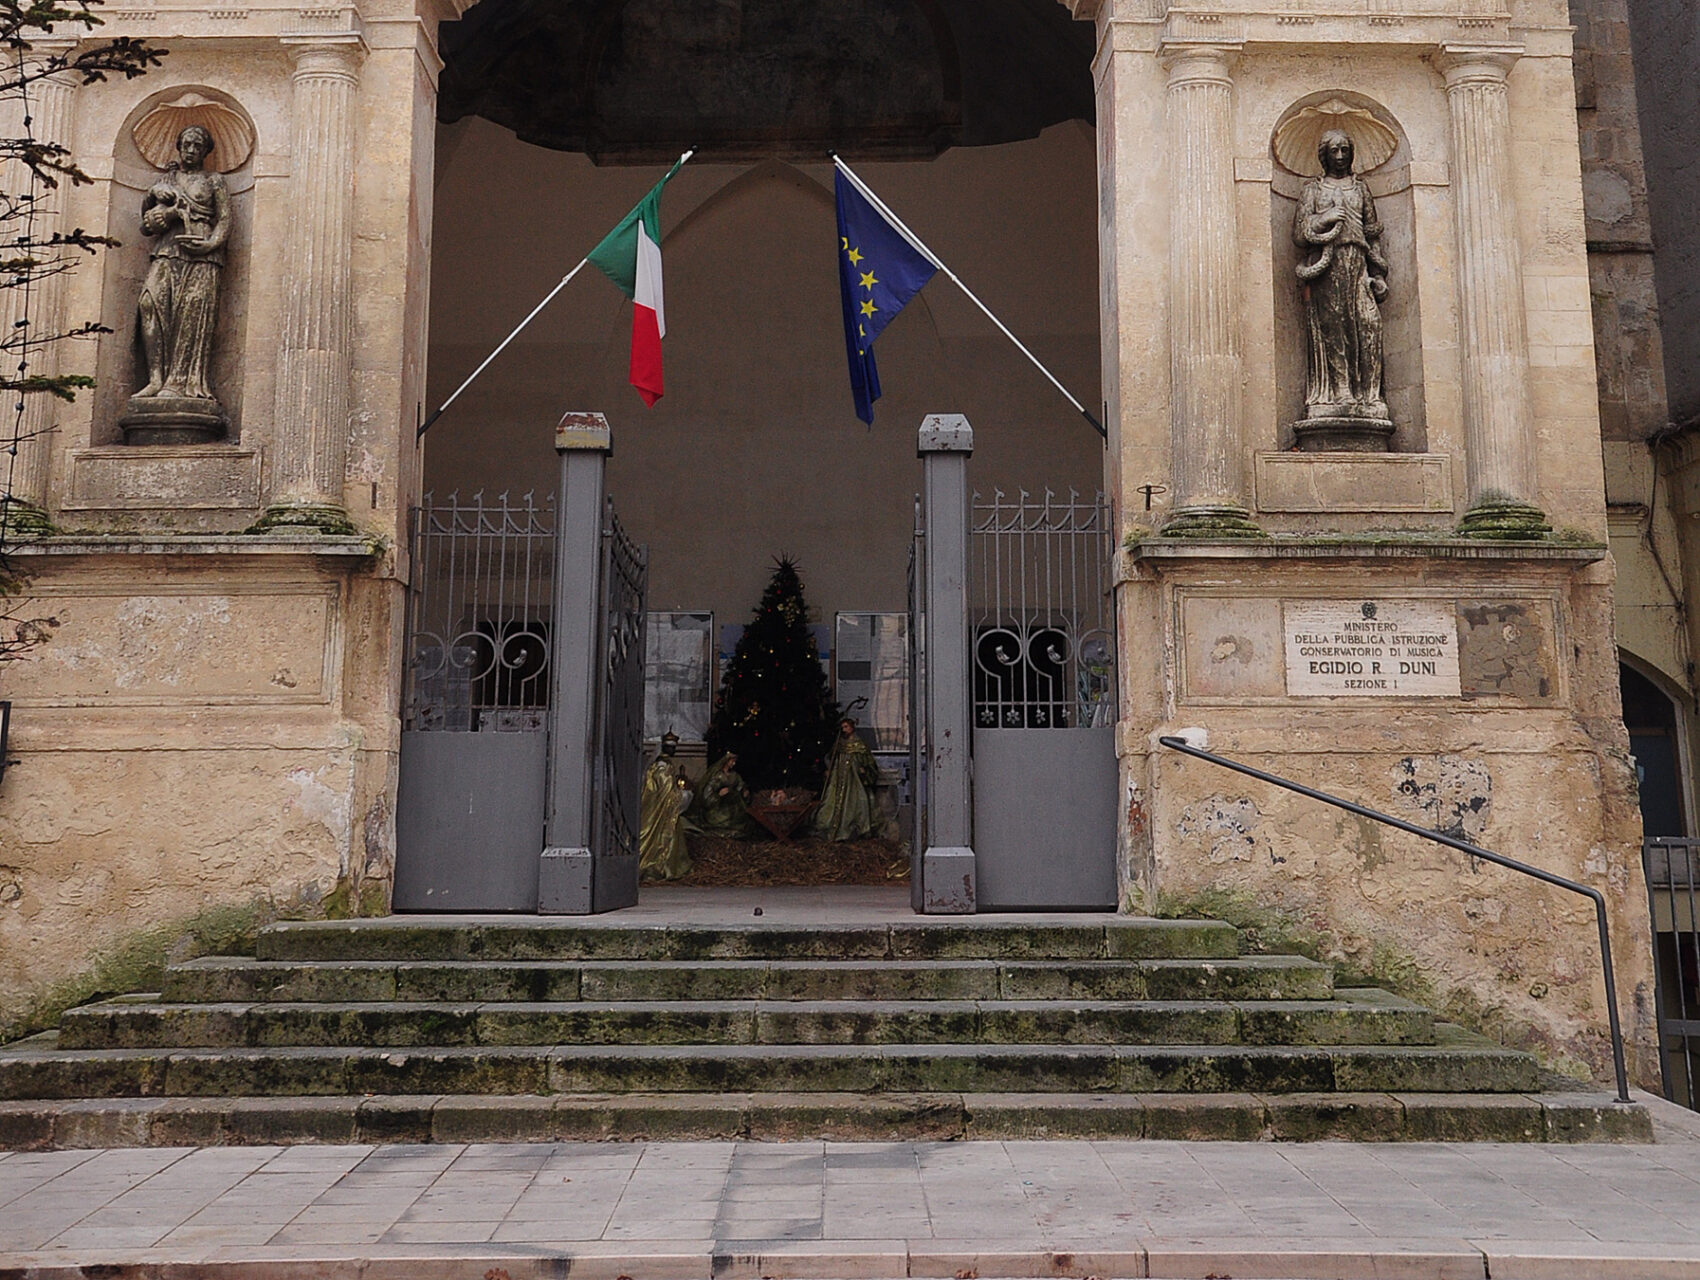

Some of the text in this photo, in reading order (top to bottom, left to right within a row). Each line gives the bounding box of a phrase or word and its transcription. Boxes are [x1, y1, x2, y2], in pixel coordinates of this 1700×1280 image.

[1344, 623, 1398, 631] MINISTERO
[1295, 635, 1448, 645] DELLA PUBBLICA ISTRUZIONE
[1300, 647, 1443, 657] CONSERVATORIO DI MUSICA
[1309, 662, 1363, 674] EGIDIO
[1400, 662, 1436, 674] DUNI
[1344, 680, 1387, 689] SEZIONE
